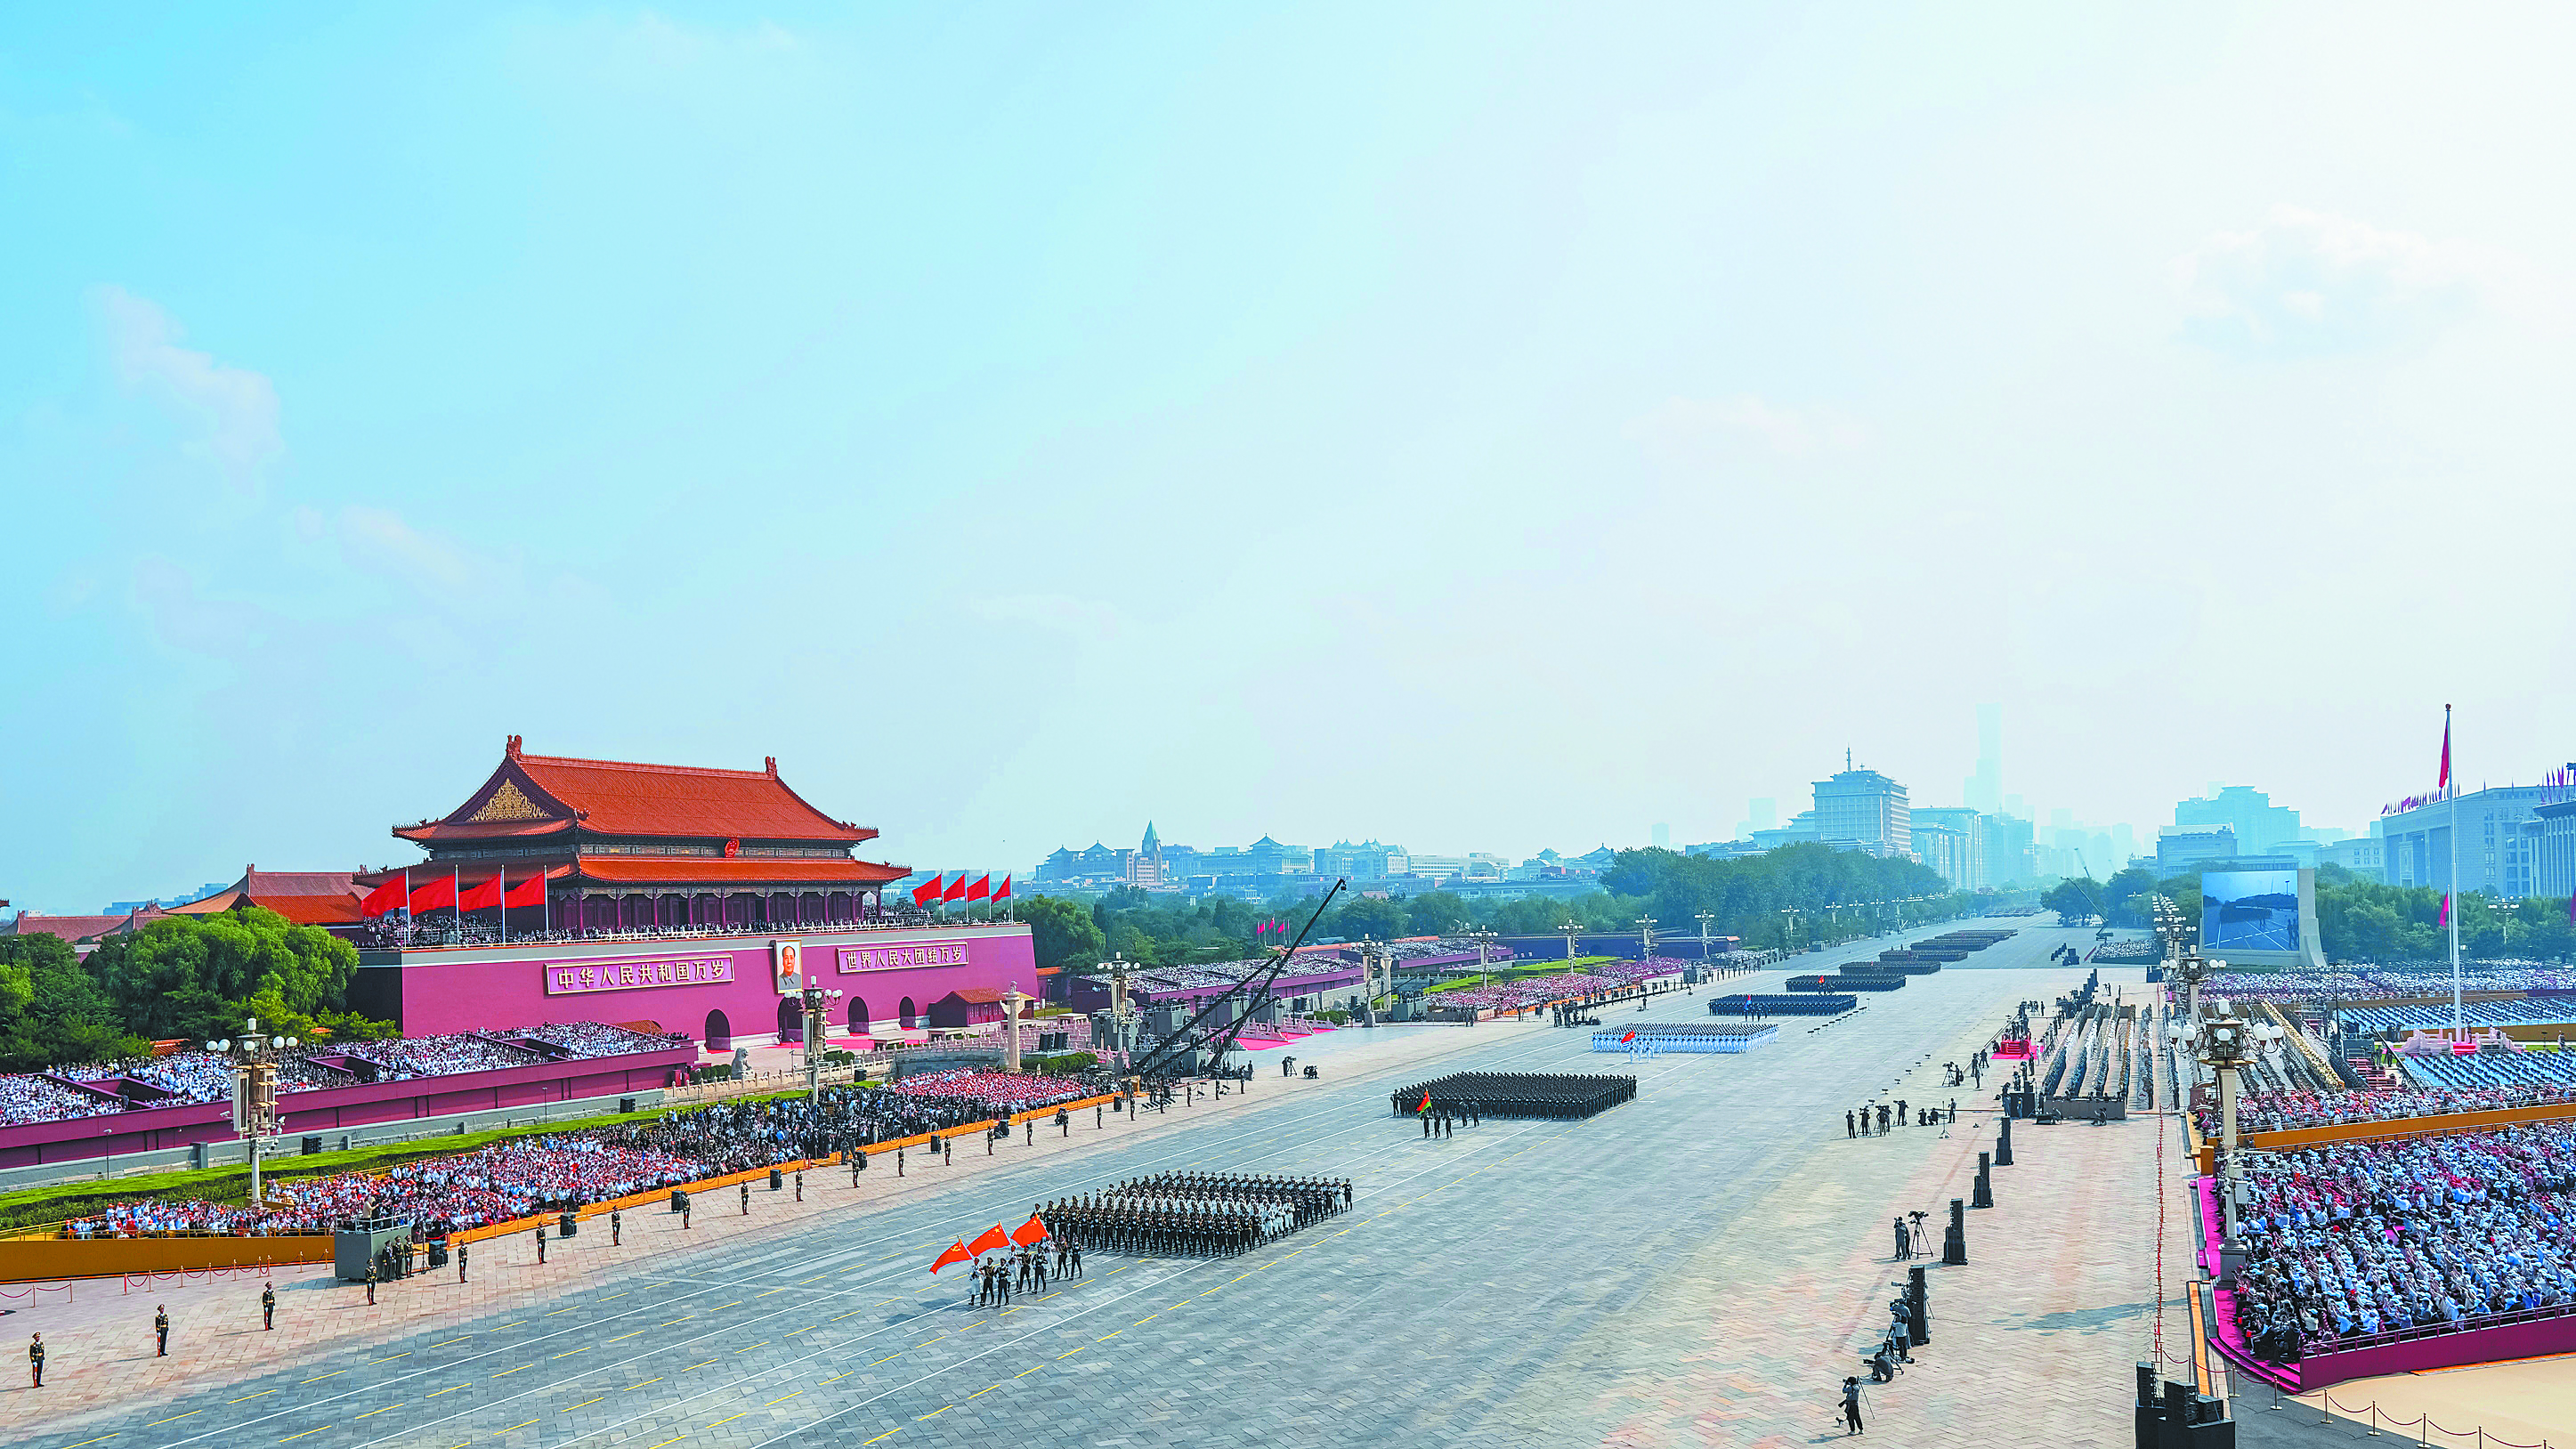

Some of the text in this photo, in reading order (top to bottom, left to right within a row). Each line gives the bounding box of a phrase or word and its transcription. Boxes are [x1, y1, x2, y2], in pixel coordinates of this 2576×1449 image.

[846, 945, 962, 969] 世界人民大团结万岁
[557, 960, 725, 989] 中华人民共和国万岁
